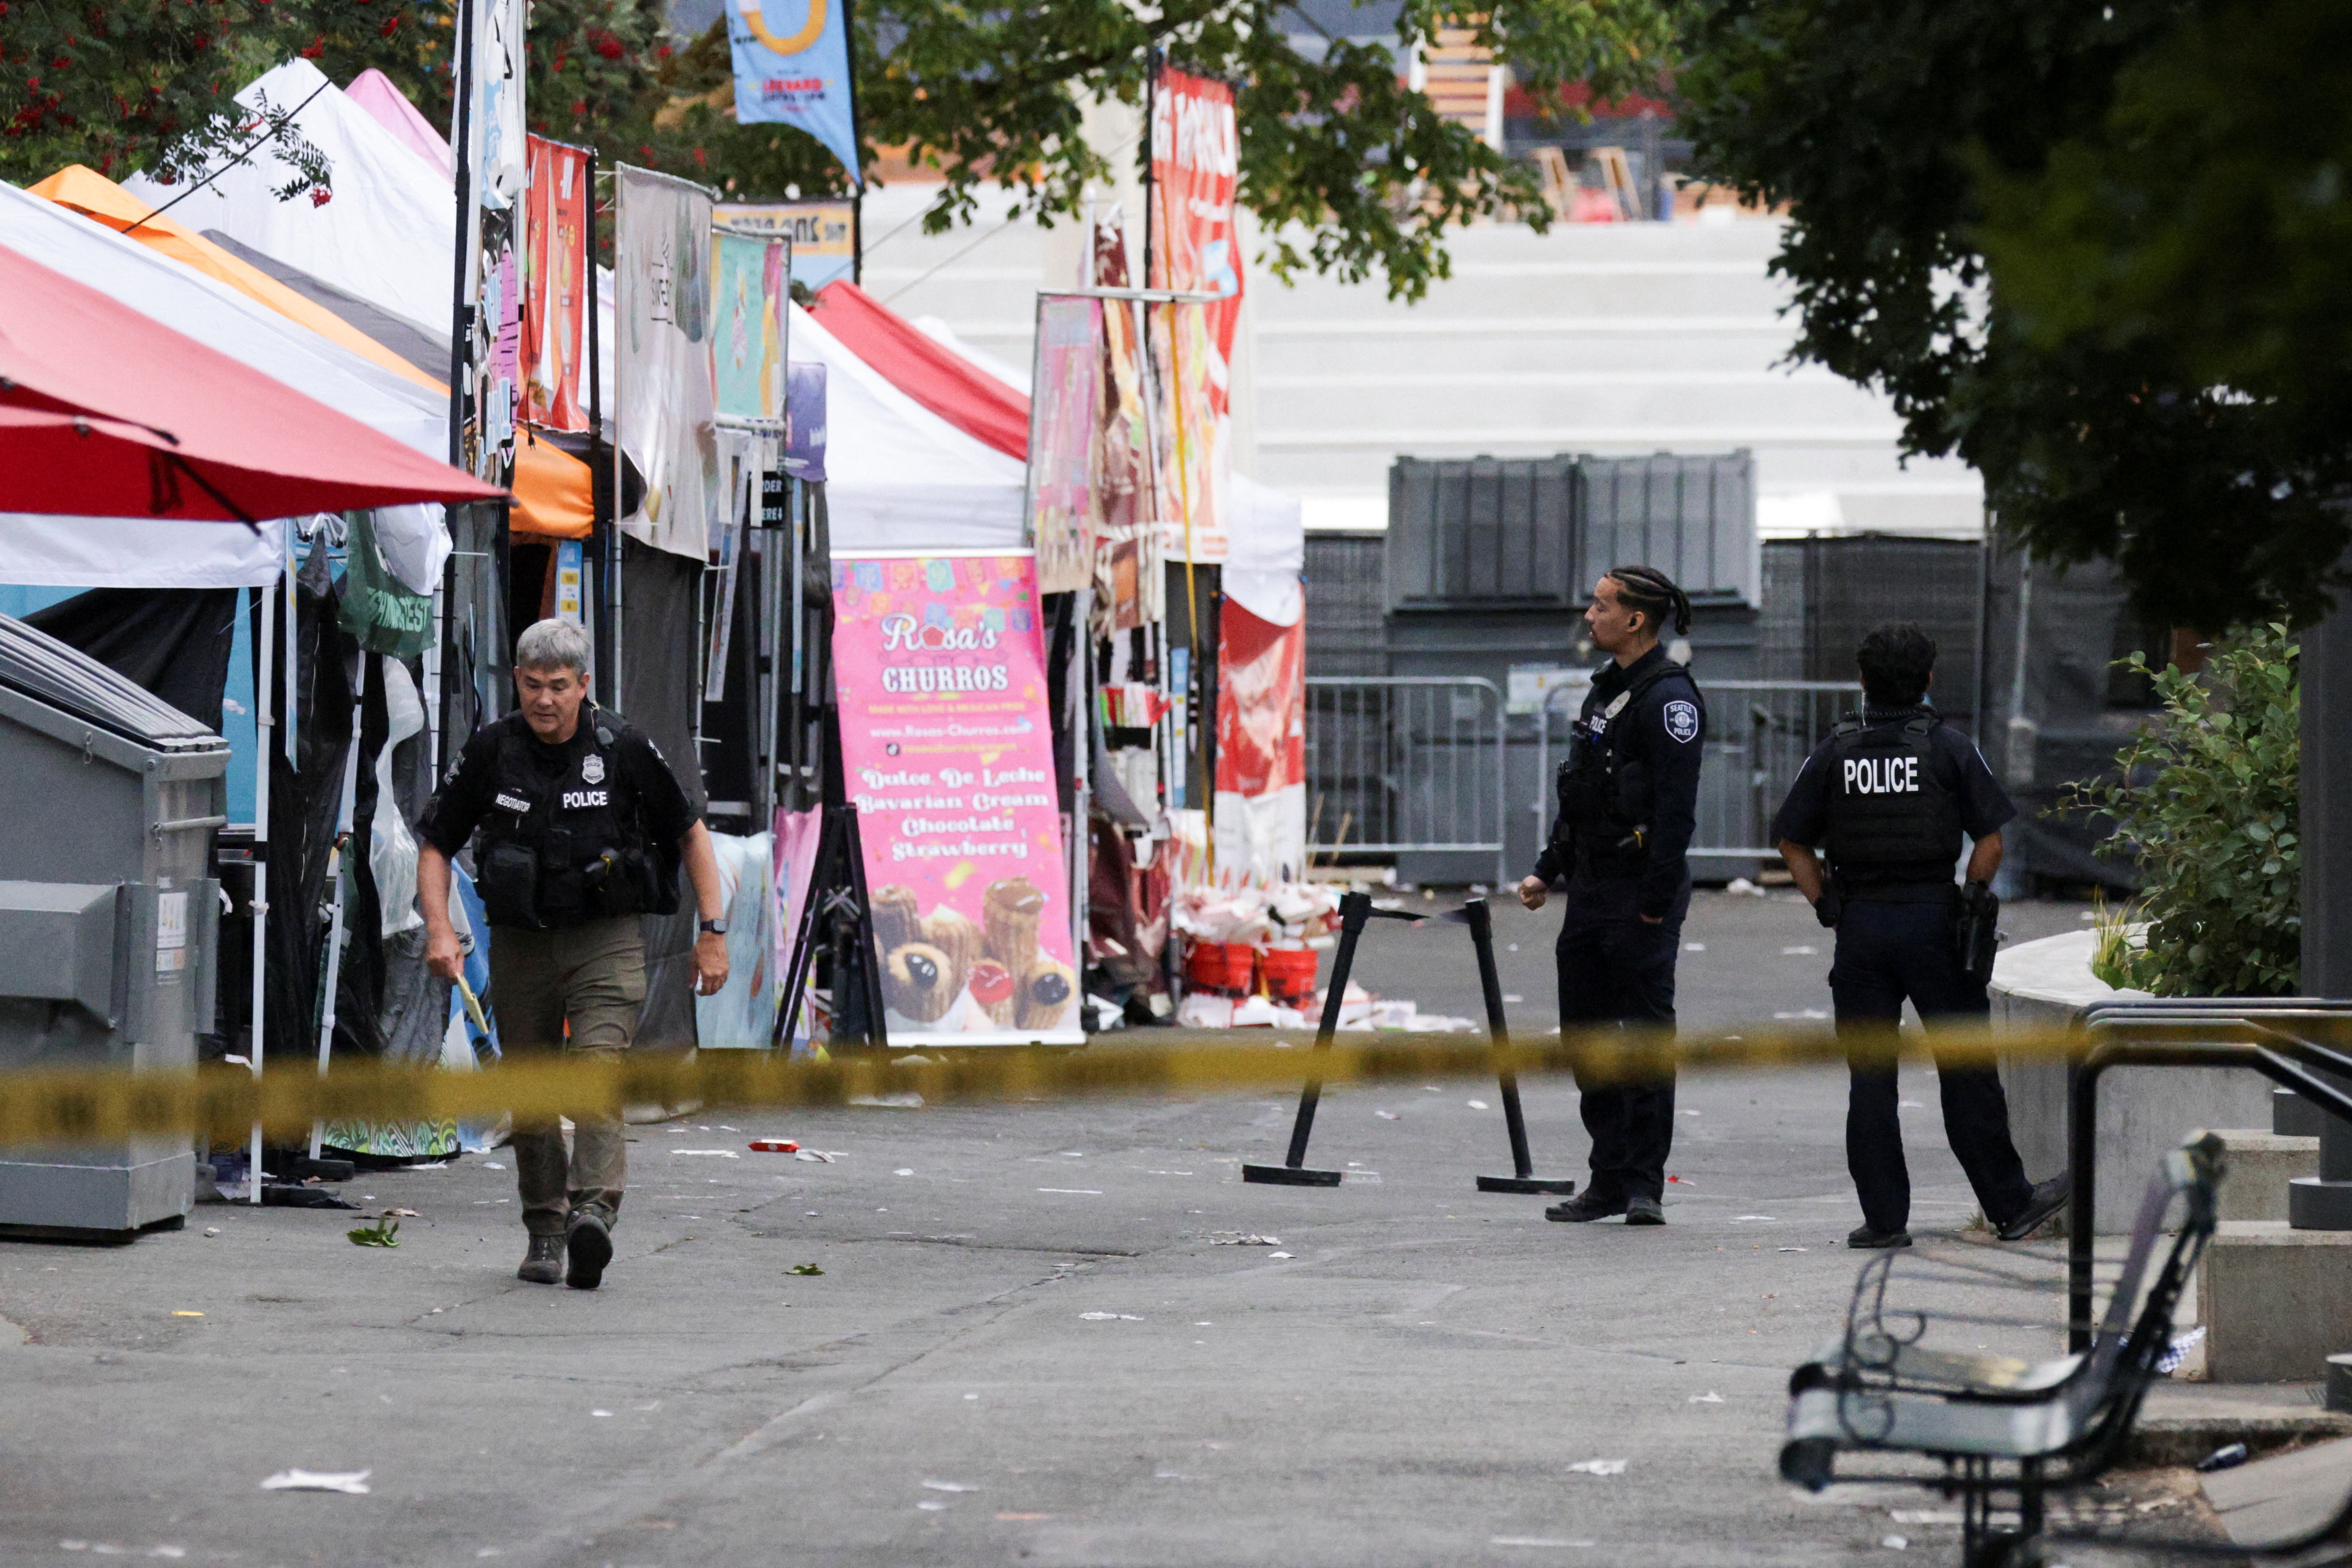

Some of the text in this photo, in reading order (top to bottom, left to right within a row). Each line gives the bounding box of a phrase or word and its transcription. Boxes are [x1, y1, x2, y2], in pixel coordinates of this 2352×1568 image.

[762, 480, 782, 493] DER
[762, 508, 777, 520] ERE
[881, 612, 1000, 651] Rosa's
[882, 664, 1009, 692] CHURROS
[1670, 704, 1692, 714] SEATTLE
[1589, 715, 1607, 734] POLICE
[1674, 727, 1691, 735] POLICE
[861, 767, 1046, 790] Dulce De Leche
[1844, 757, 1919, 794] POLICE
[496, 793, 531, 813] NEGOTIATOR
[563, 791, 608, 808] POLICE
[852, 792, 1049, 814] Bavarian Cream
[901, 816, 1015, 837] Chocolate
[892, 840, 1028, 861] Strawberry
